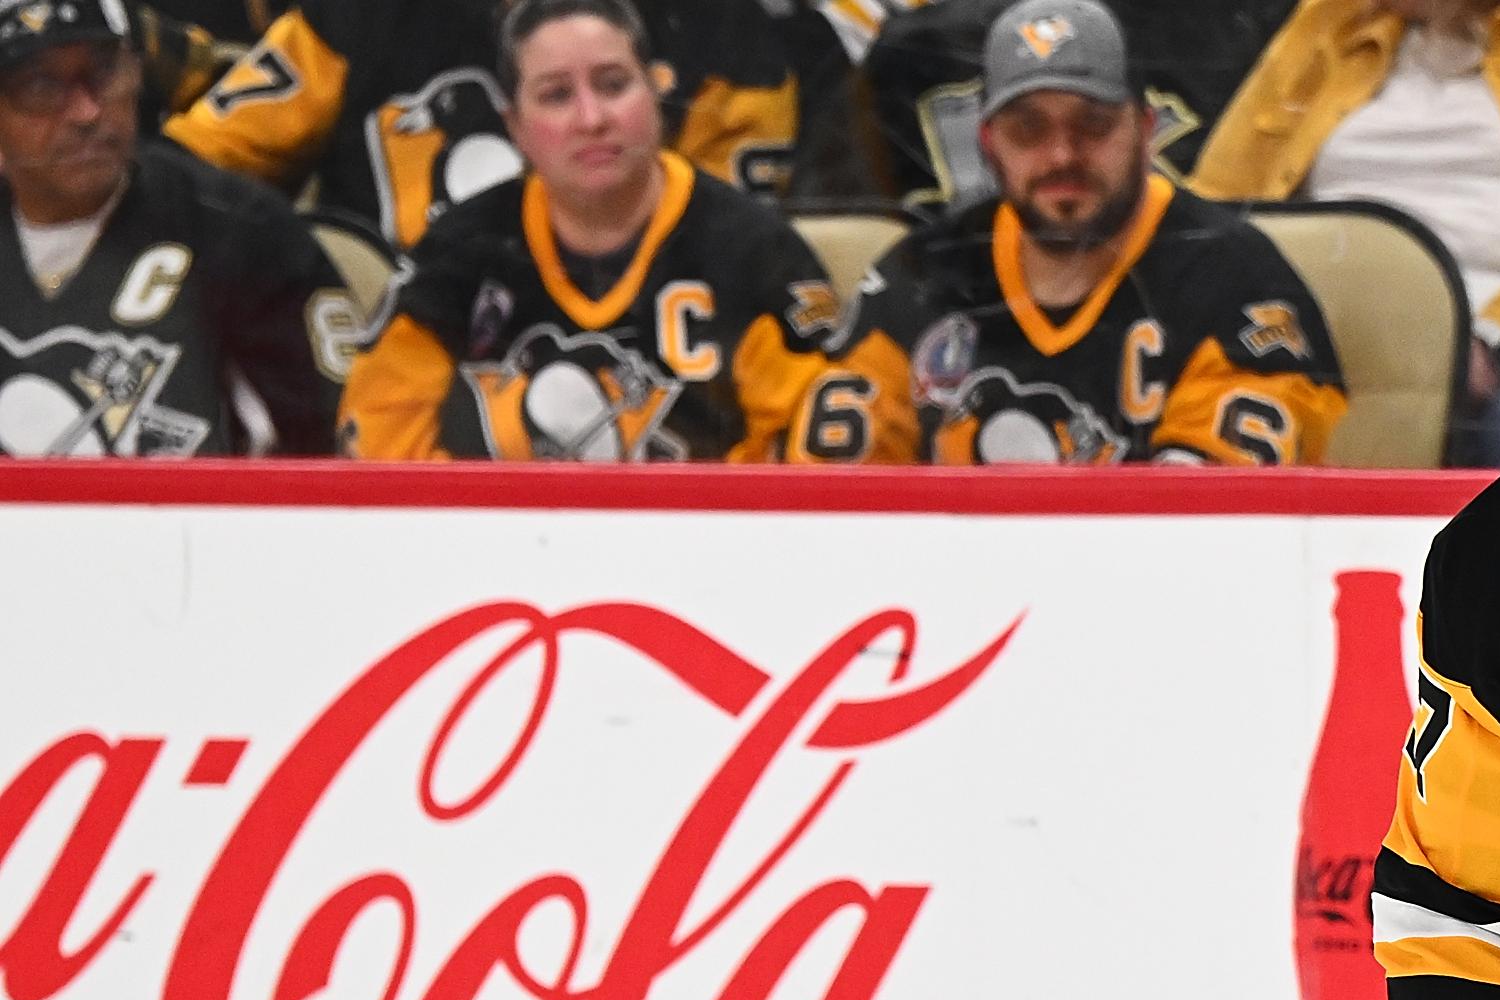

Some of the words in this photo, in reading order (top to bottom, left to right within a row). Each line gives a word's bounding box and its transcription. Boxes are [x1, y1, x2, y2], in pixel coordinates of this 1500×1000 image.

[210, 48, 300, 115] 7
[110, 241, 193, 327] C
[655, 280, 721, 381] C
[1119, 318, 1166, 425] C
[803, 374, 876, 460] 6
